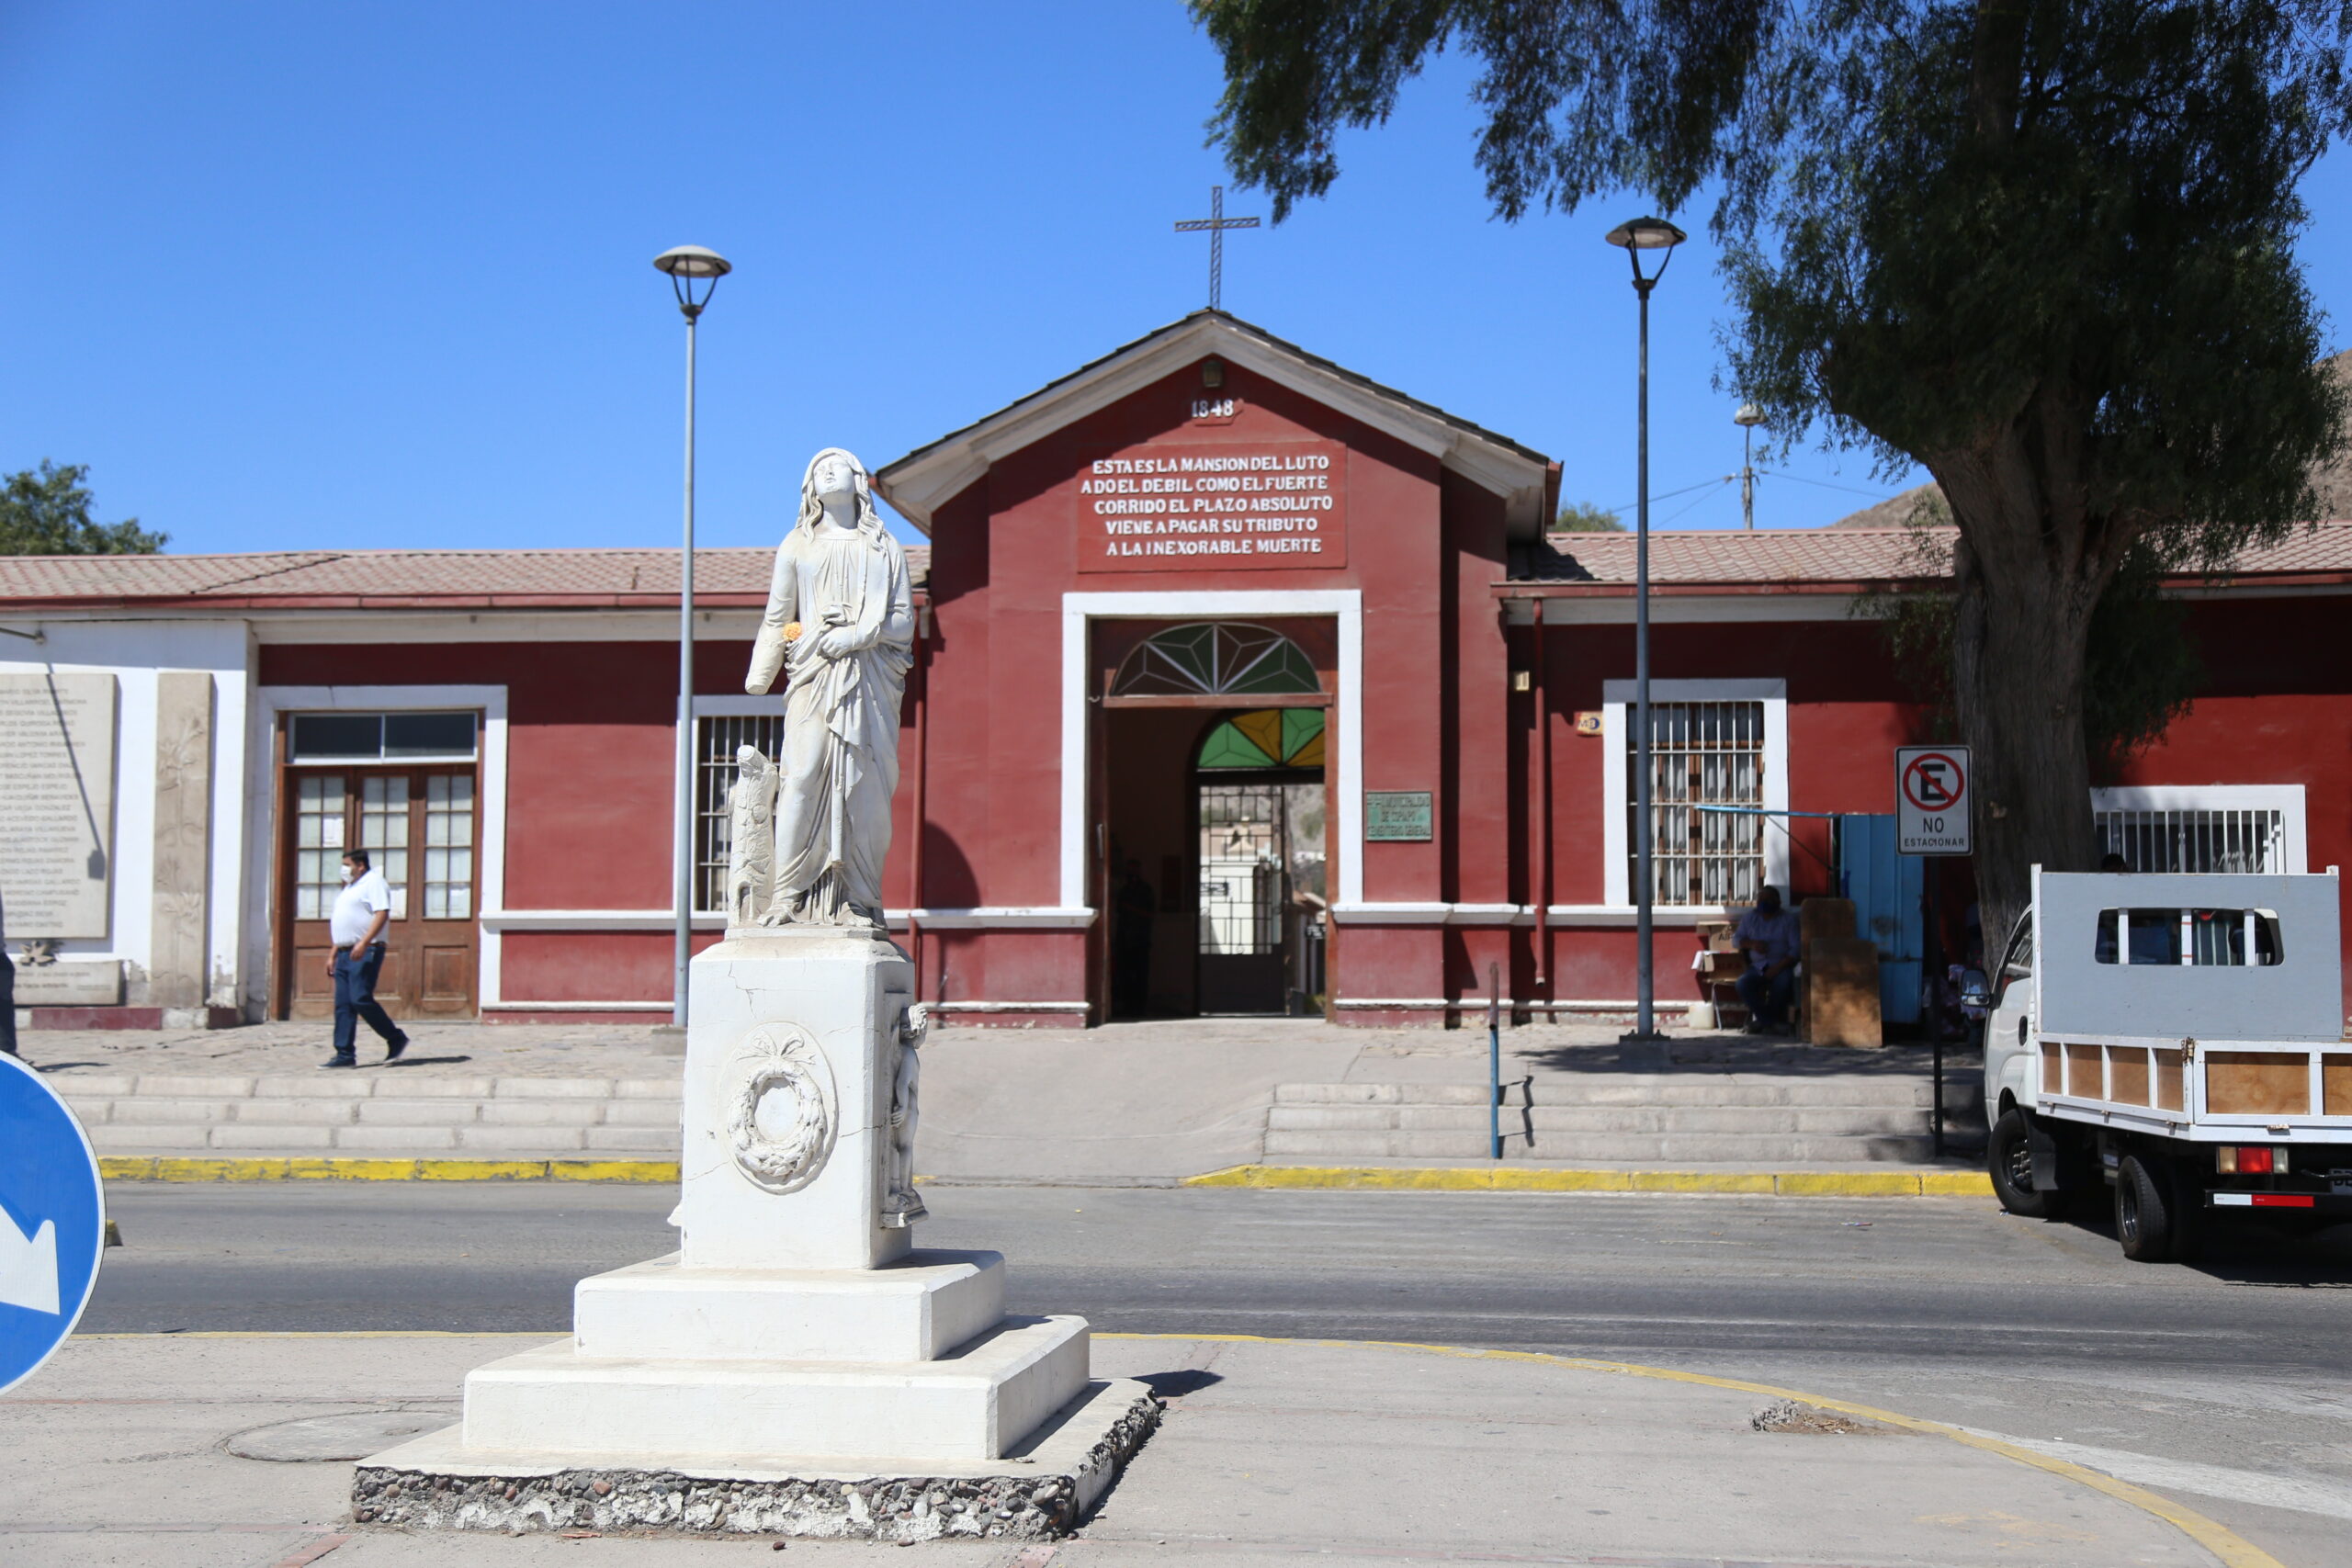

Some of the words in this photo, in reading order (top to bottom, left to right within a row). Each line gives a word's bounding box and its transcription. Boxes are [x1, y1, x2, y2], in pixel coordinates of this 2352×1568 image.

[1192, 399, 1234, 418] 1848
[1092, 459, 1133, 475] ESTA
[1135, 459, 1155, 474] ES
[1157, 458, 1178, 473] LA
[1181, 457, 1249, 472] MANSION
[1250, 457, 1283, 471] DEL
[1285, 456, 1329, 470] LUTO
[1080, 479, 1091, 494] A
[1093, 479, 1117, 494] DO
[1117, 479, 1139, 493] EL
[1142, 478, 1193, 493] DEBIL
[1195, 477, 1240, 492] COMO
[1242, 477, 1264, 491] EL
[1265, 476, 1329, 491] FUERTE
[1094, 499, 1167, 514] CORRIDO
[1169, 499, 1190, 513] EL
[1193, 498, 1248, 513] PLAZO
[1250, 496, 1333, 512] ABSOLUTO
[1106, 520, 1153, 535] VIENE
[1156, 520, 1167, 534] A
[1169, 518, 1219, 534] PAGAR
[1222, 519, 1243, 533] SU
[1245, 517, 1318, 533] TRIBUTO
[1106, 541, 1118, 556] A
[1121, 542, 1143, 556] LA
[1146, 539, 1252, 556] INEXORABLE
[1257, 538, 1322, 554] MUERTE
[1924, 817, 1944, 834] NO
[1904, 837, 1964, 847] ESTACIONAR
